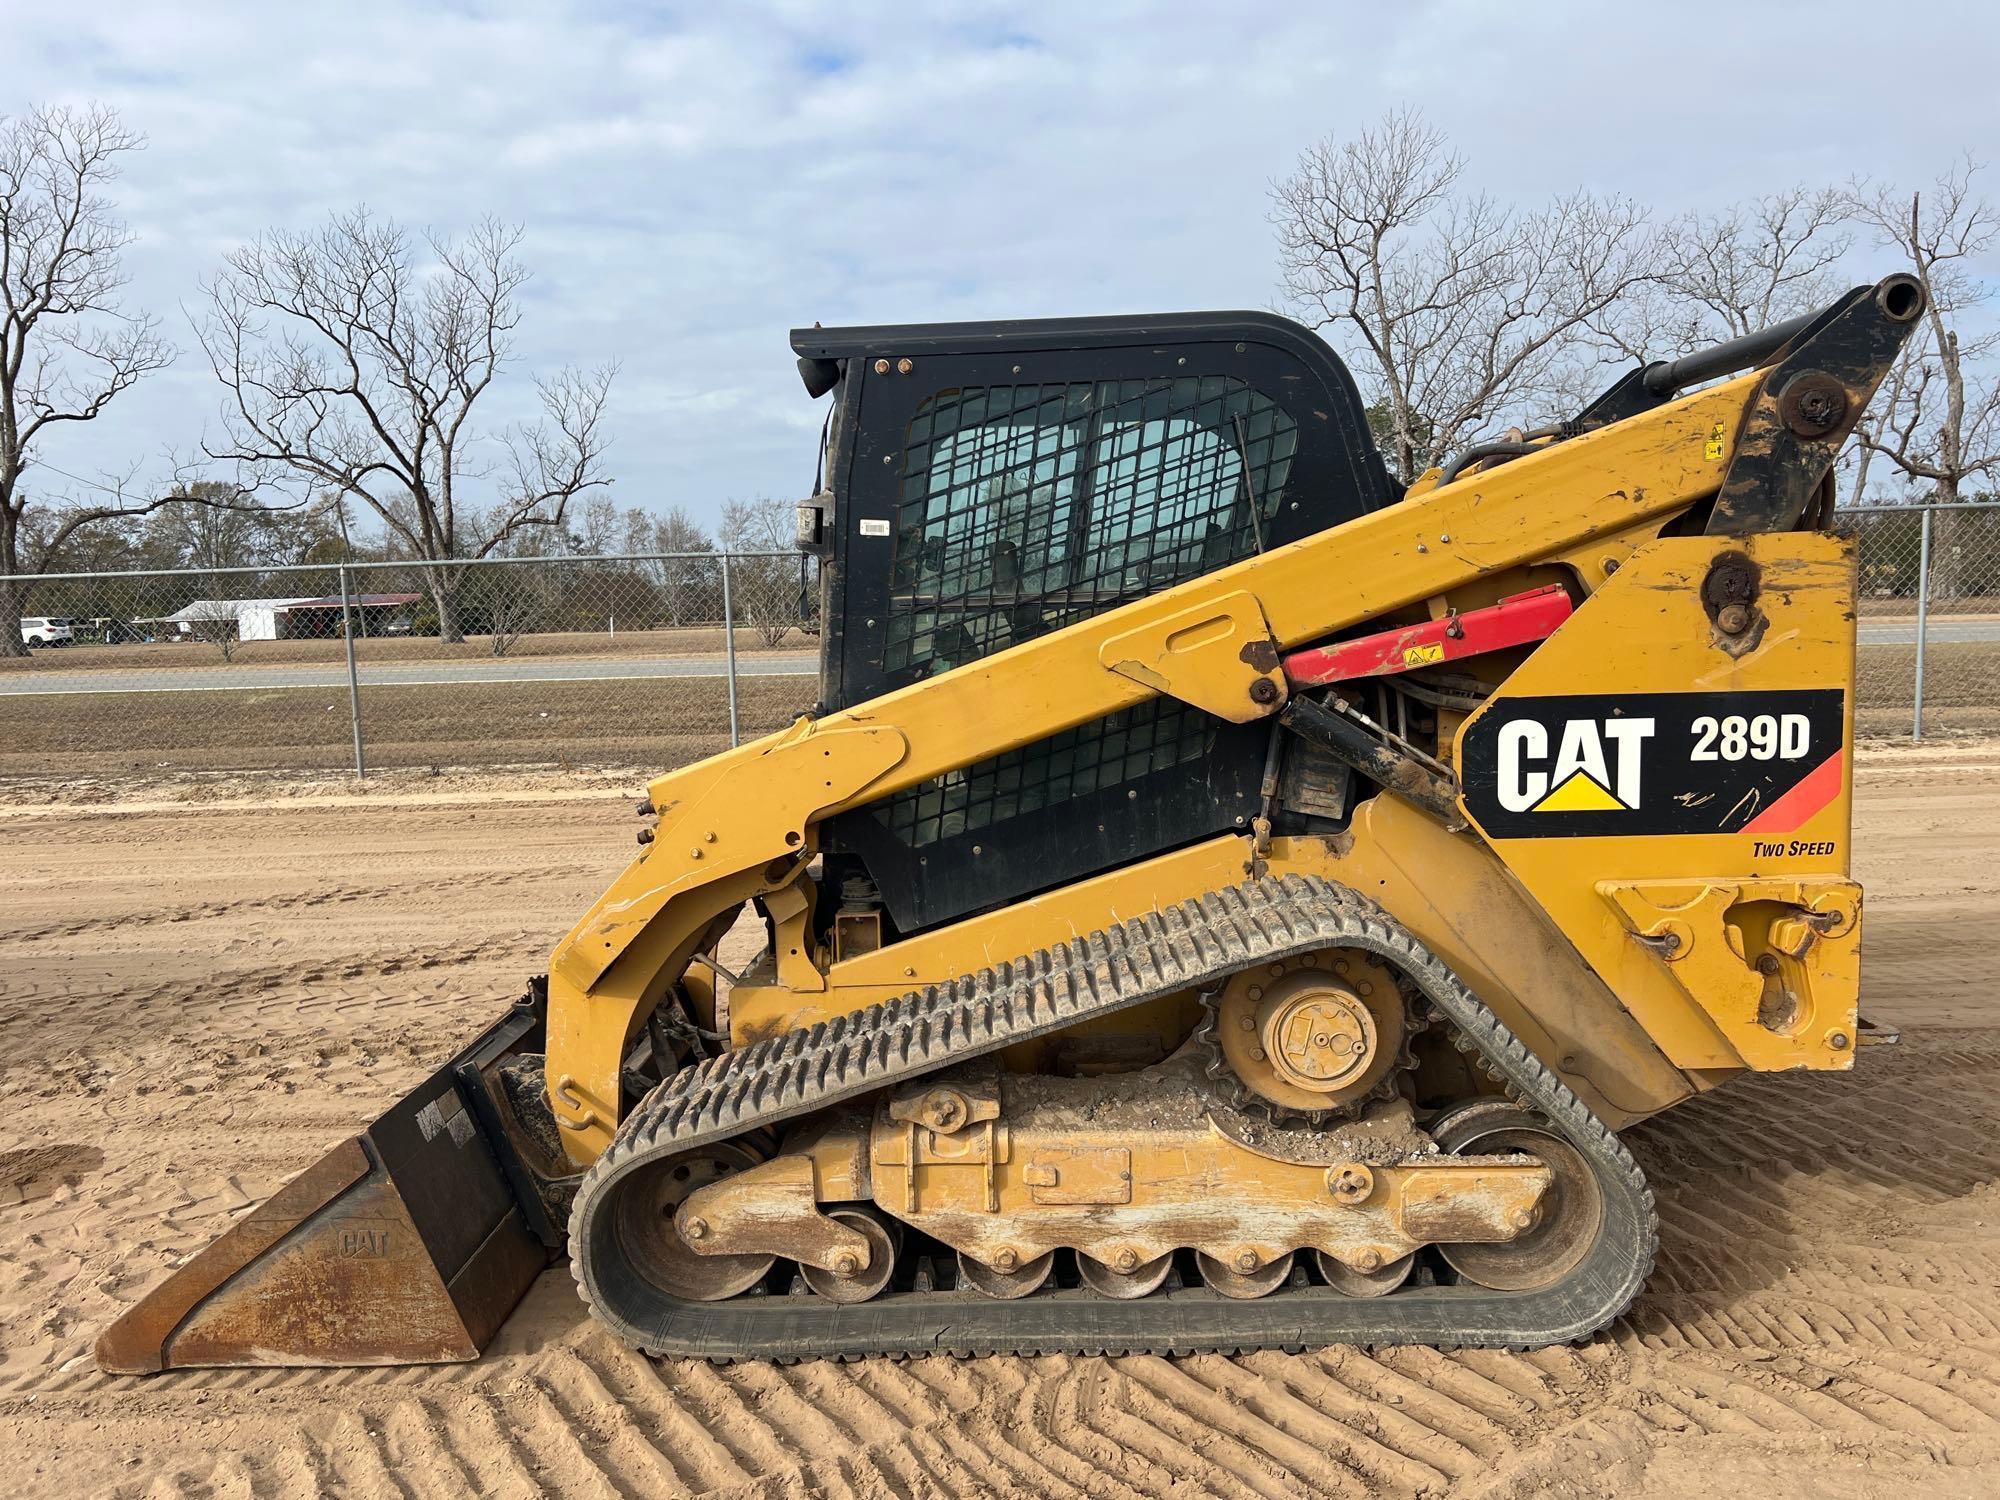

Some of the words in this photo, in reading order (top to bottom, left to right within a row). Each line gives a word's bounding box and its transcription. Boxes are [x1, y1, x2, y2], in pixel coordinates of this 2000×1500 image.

[1497, 717, 1655, 812] CAT
[1690, 713, 1810, 762] 289D
[338, 1229, 387, 1257] CAT
